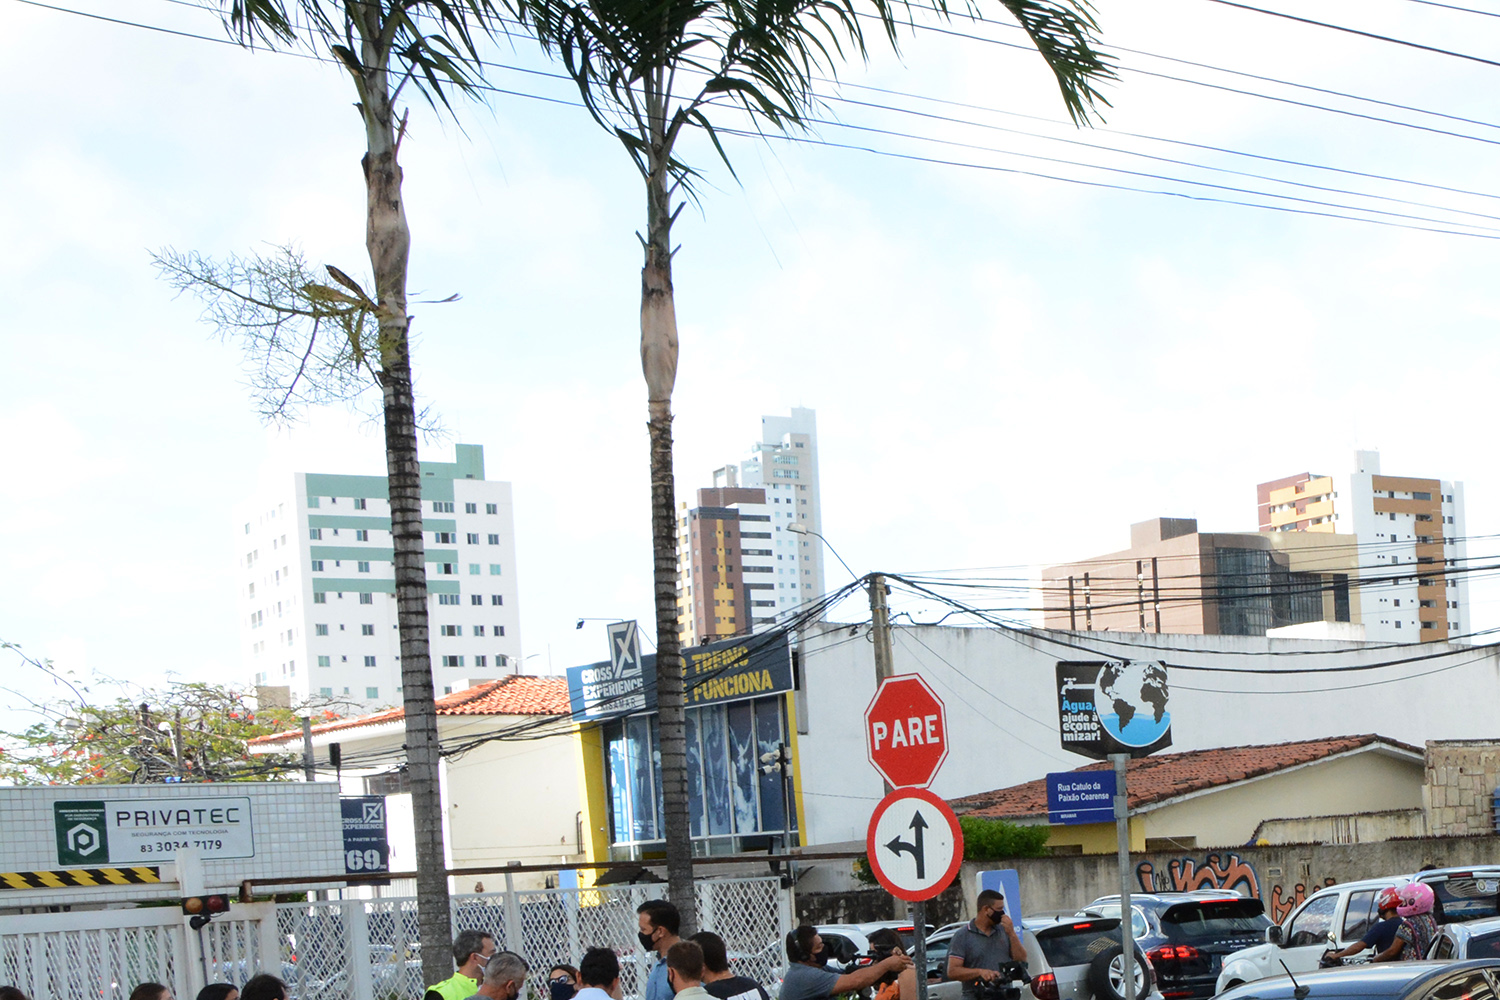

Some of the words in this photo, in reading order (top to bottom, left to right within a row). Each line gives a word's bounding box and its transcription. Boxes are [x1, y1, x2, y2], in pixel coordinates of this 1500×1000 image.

[581, 666, 612, 684] CROSS
[582, 678, 644, 700] EXPERIENCE
[693, 669, 774, 701] FUNCIONA
[1062, 696, 1096, 714] Água,
[1062, 712, 1089, 723] ajude
[872, 714, 940, 750] PARE
[1062, 722, 1100, 731] econo-
[1063, 730, 1101, 741] mizar!
[1071, 782, 1092, 791] Catulo
[1058, 793, 1079, 802] Paixão
[1081, 792, 1109, 800] Cearense
[116, 808, 240, 826] PRIVATEC
[140, 844, 153, 853] 83
